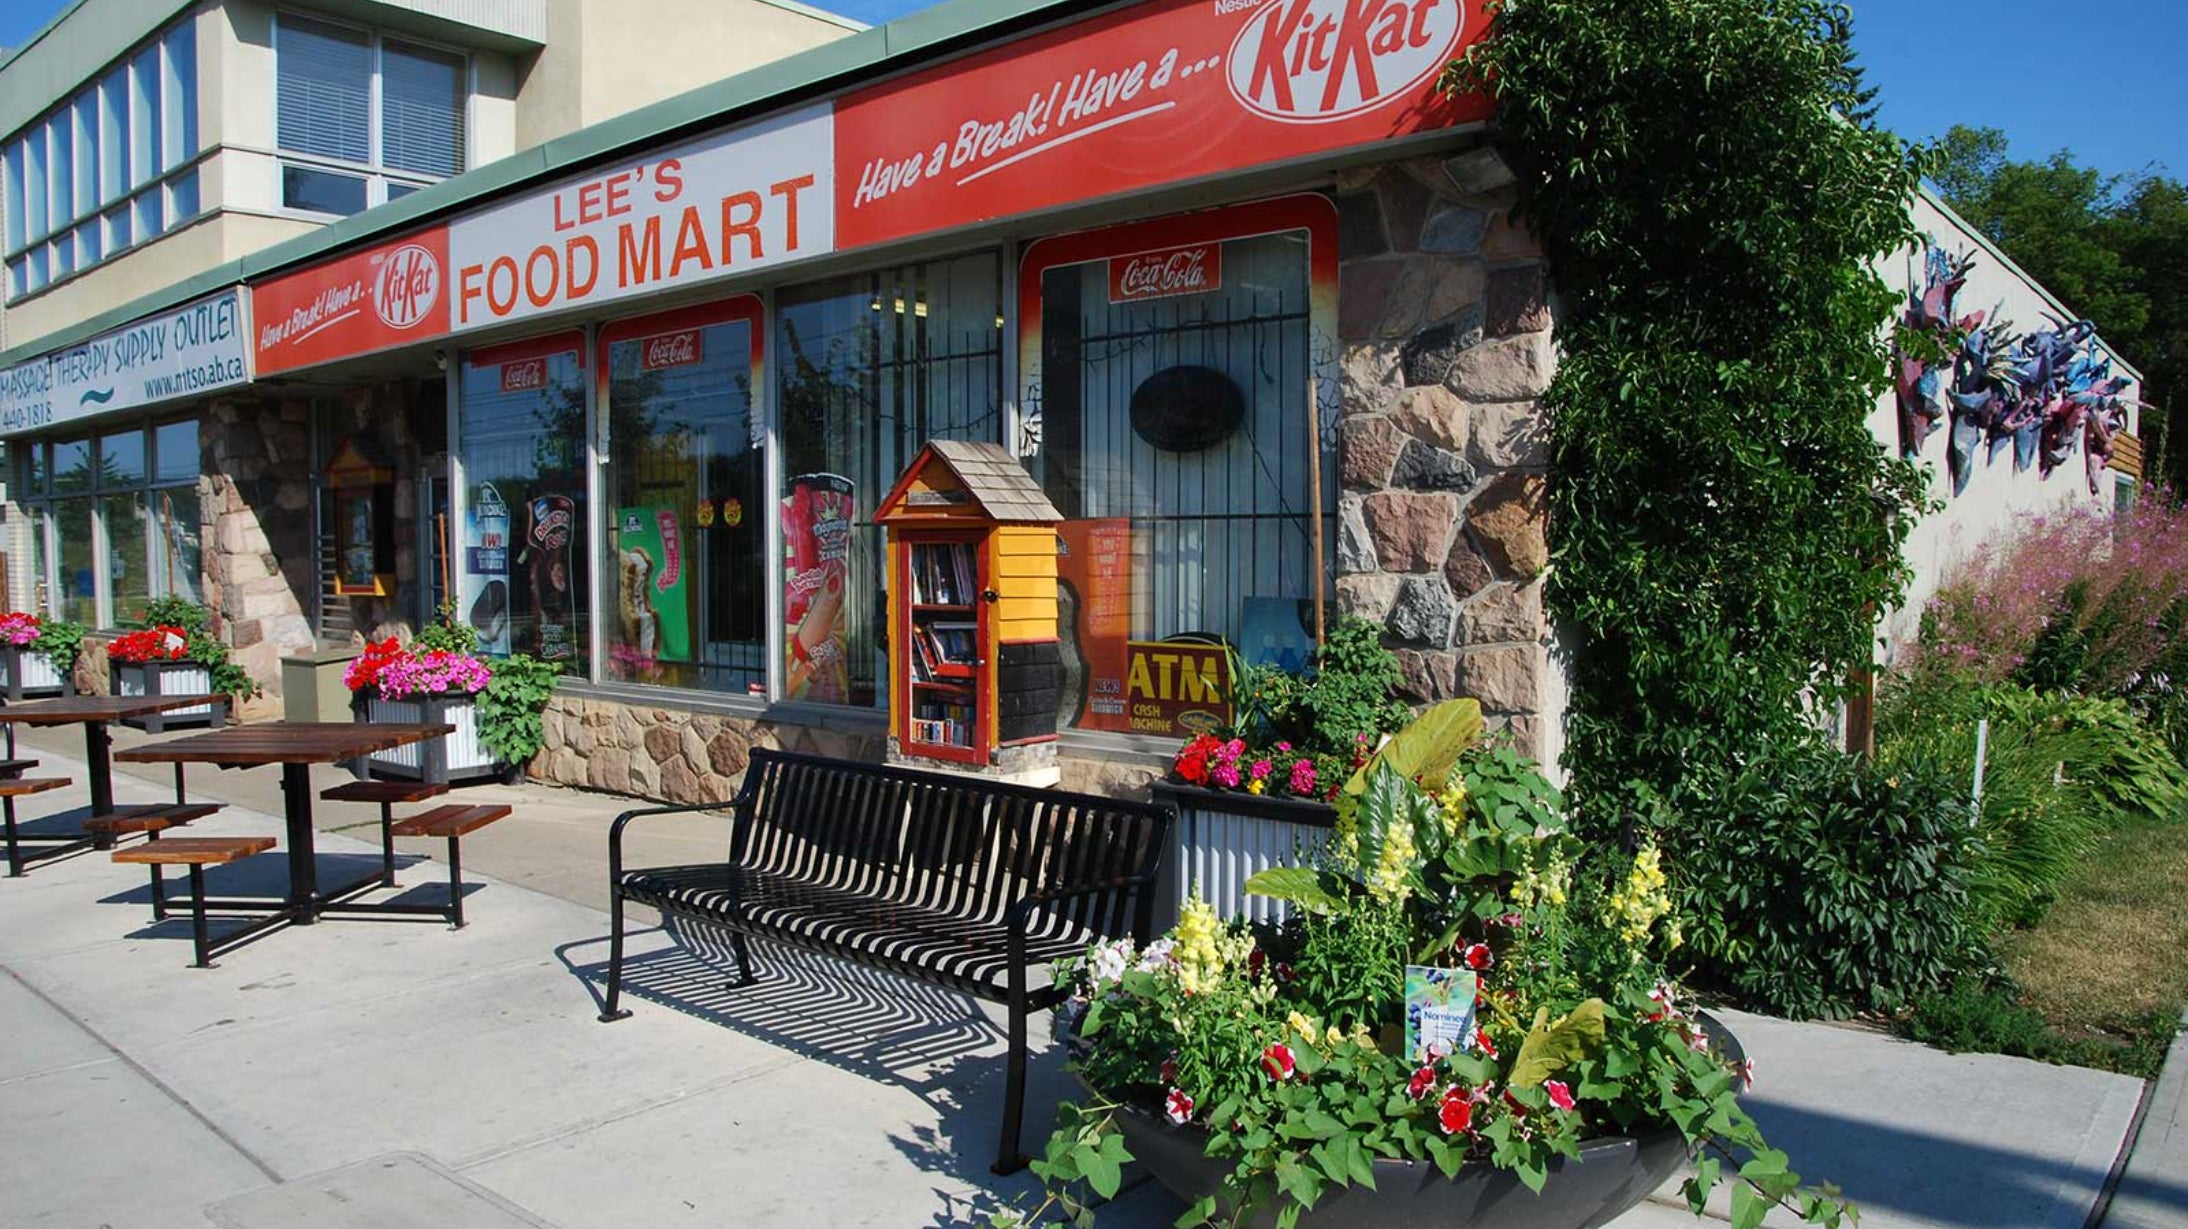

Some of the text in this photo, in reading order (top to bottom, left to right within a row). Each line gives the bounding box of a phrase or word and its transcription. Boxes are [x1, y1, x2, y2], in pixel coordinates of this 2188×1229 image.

[1214, 0, 1261, 16] Nest
[854, 158, 922, 208] Have
[925, 142, 947, 179] a
[950, 82, 1061, 168] Break!
[1057, 60, 1147, 126] Have
[553, 158, 683, 232] LEE'S
[459, 173, 814, 323] FOOD MART
[381, 251, 433, 322] KitKat
[54, 342, 110, 387] THERAPY
[114, 322, 167, 373] SUPPLY
[174, 296, 236, 352] OUTLET
[260, 324, 285, 351] Have
[144, 355, 243, 399] www.mtso.ab.ca
[1128, 652, 1221, 704] ATM
[1133, 703, 1161, 718] CASH
